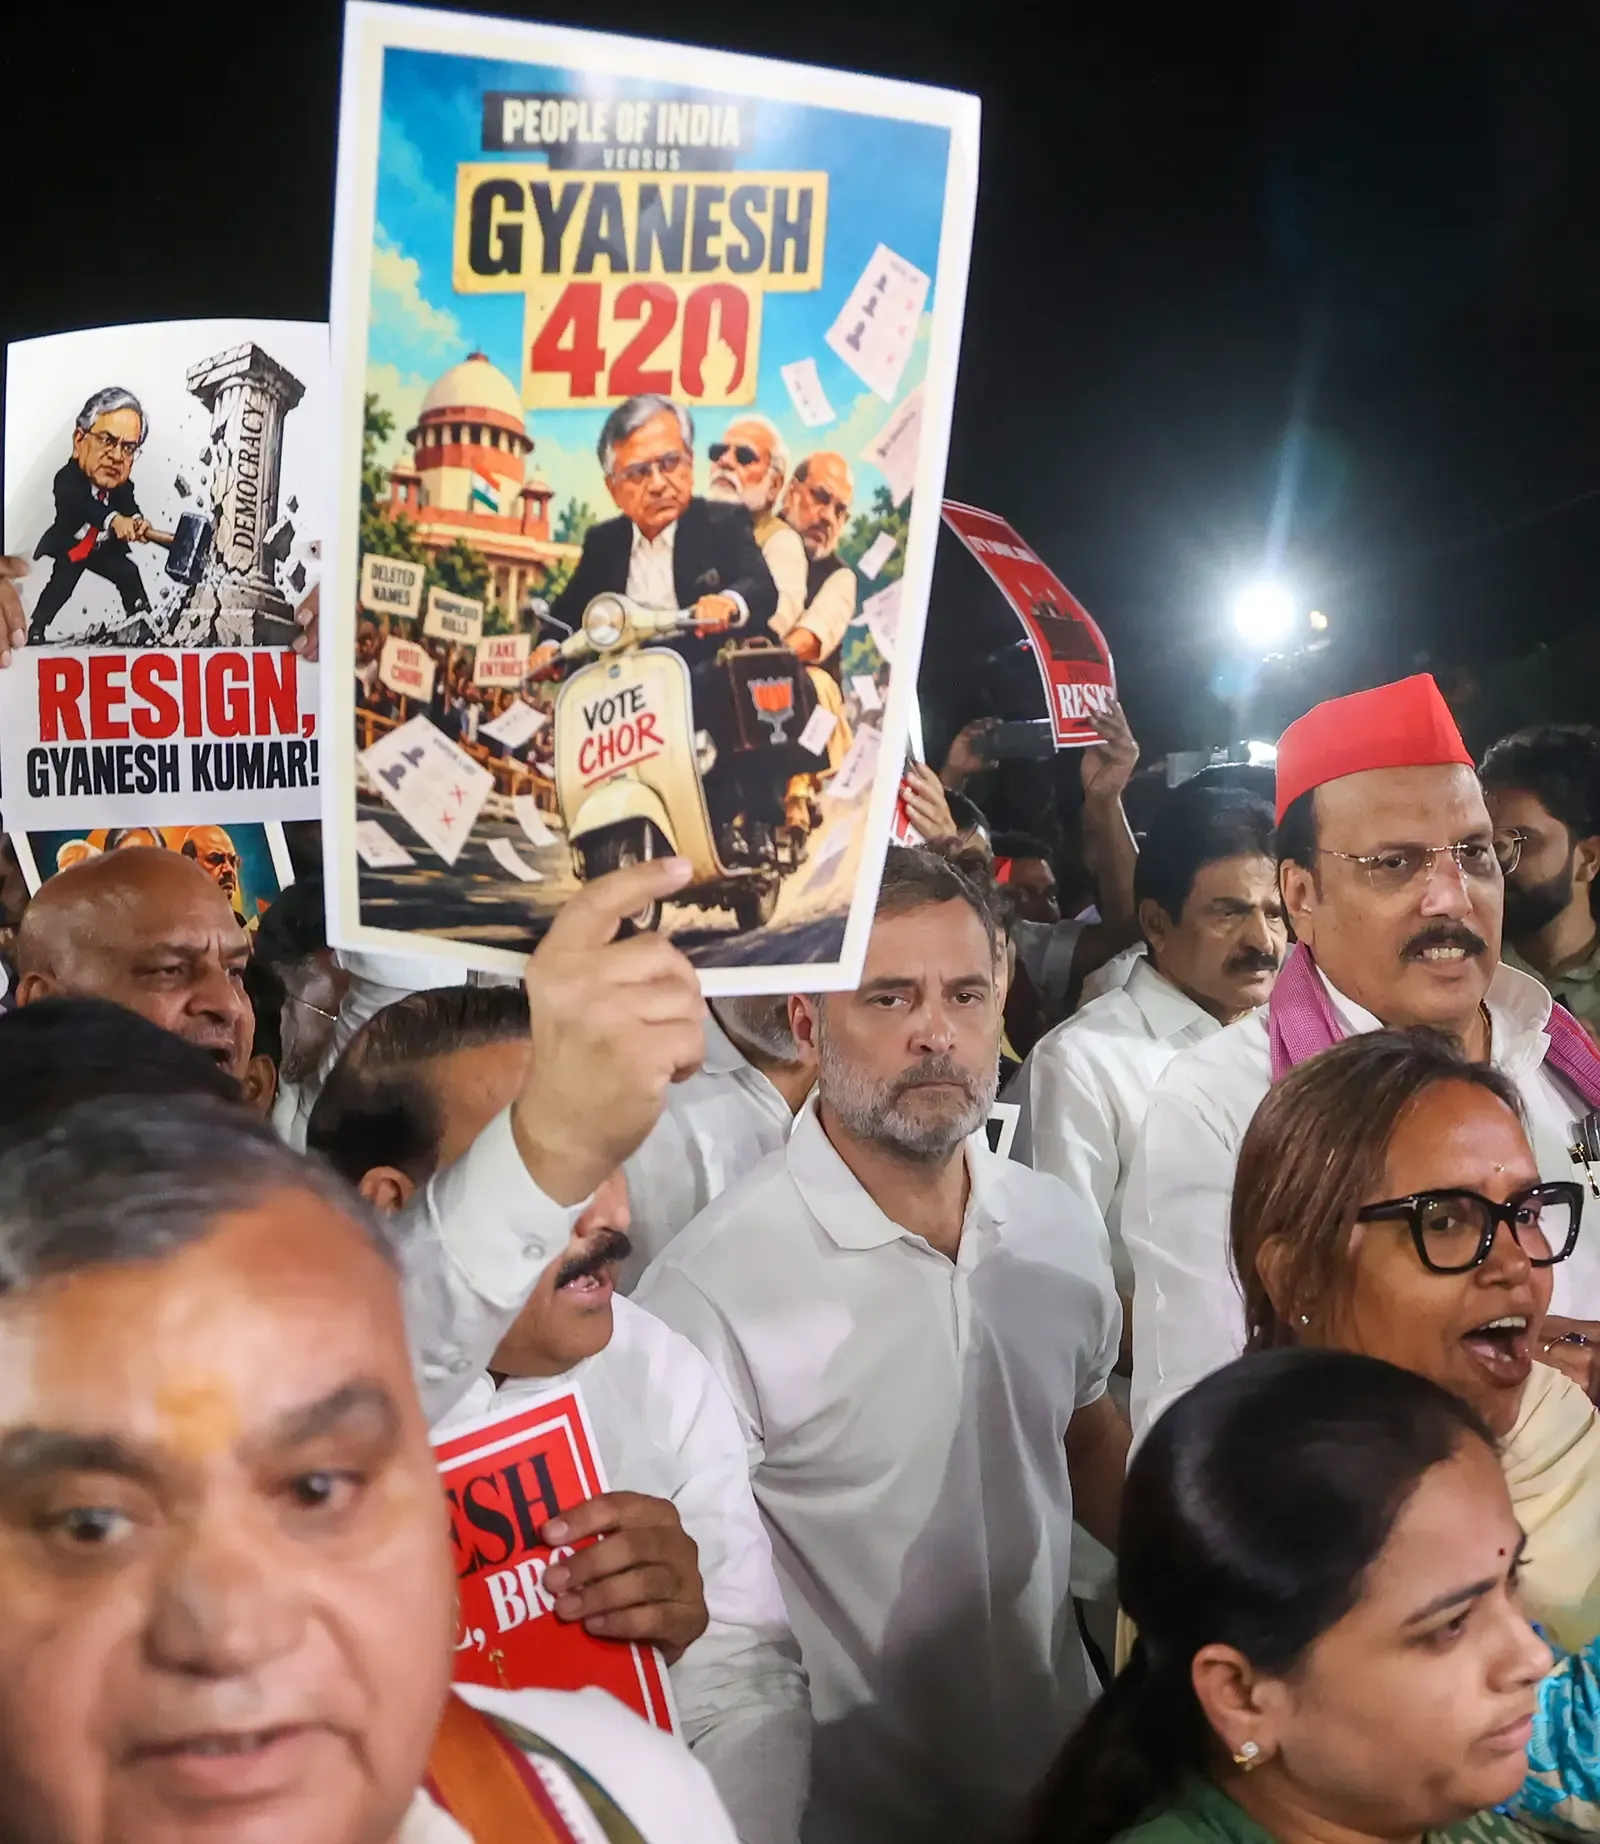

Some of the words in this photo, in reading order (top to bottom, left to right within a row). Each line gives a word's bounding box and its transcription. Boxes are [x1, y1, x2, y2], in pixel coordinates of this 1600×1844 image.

[502, 98, 608, 144] PEOPLE
[615, 100, 651, 145] OF
[656, 102, 741, 148] INDIA
[602, 148, 681, 171] VERSUS
[468, 178, 813, 276] GYANESH
[530, 281, 750, 399] 420
[232, 399, 264, 552] DEMOCRACY
[371, 563, 415, 587] DELETED
[372, 585, 410, 606] NAMES
[37, 651, 317, 742] RESIGN,
[583, 684, 646, 731] VOTE
[27, 743, 181, 798] GYANESH
[191, 739, 320, 793] KUMAR!
[578, 712, 664, 775] CHOR
